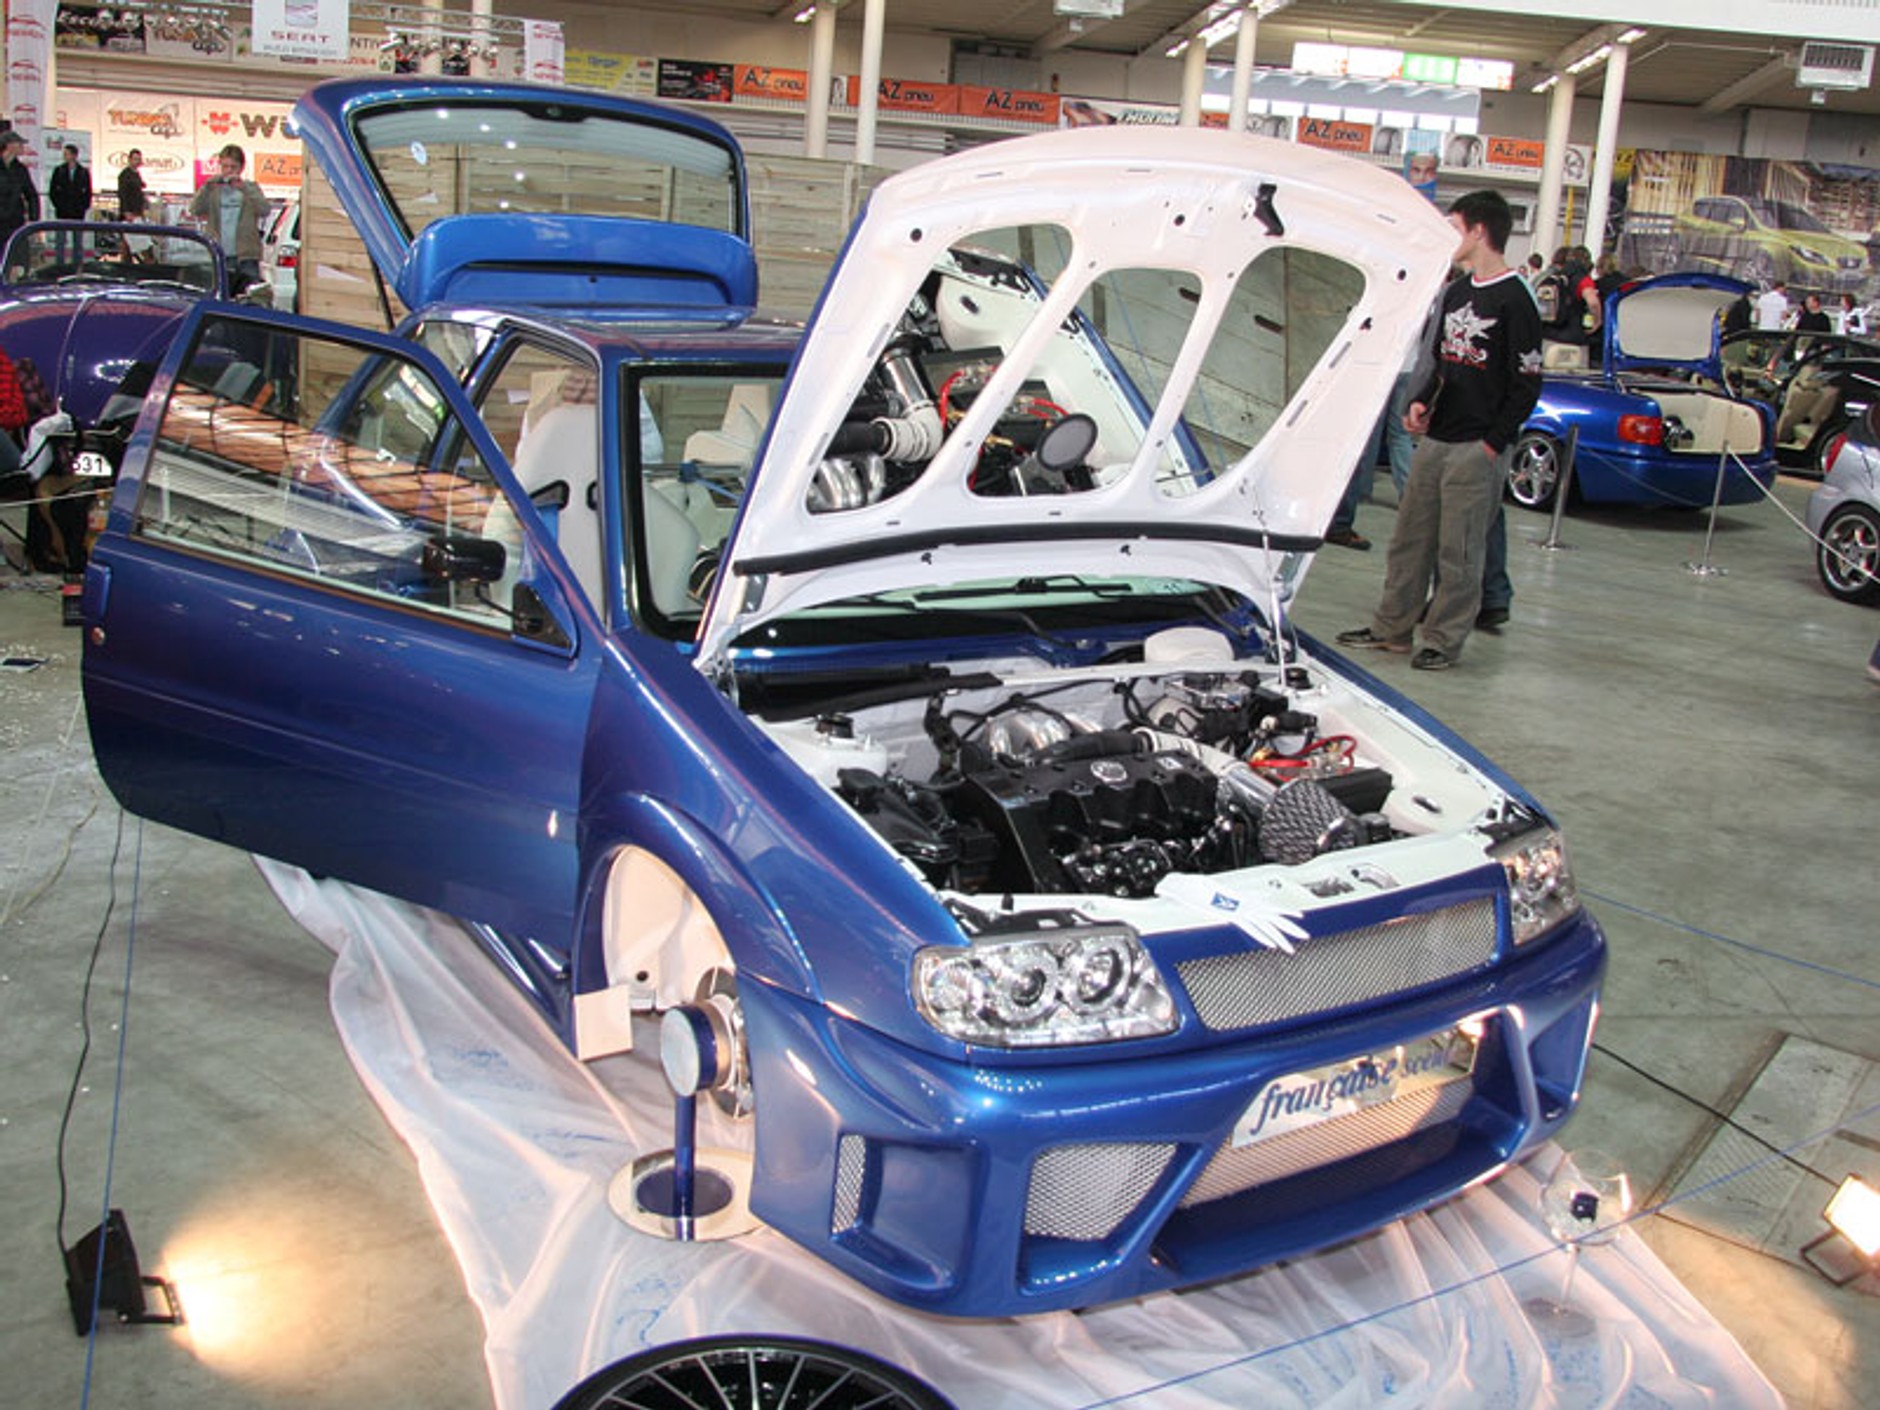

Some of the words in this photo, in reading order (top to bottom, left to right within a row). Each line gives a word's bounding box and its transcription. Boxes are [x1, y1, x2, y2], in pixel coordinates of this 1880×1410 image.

[270, 30, 330, 43] SEAT
[744, 68, 771, 88] AZ
[878, 80, 902, 99] AZ
[986, 90, 1012, 110] AZ
[1304, 118, 1331, 139] AZ
[1334, 128, 1364, 144] pneu
[262, 158, 286, 176] AZ
